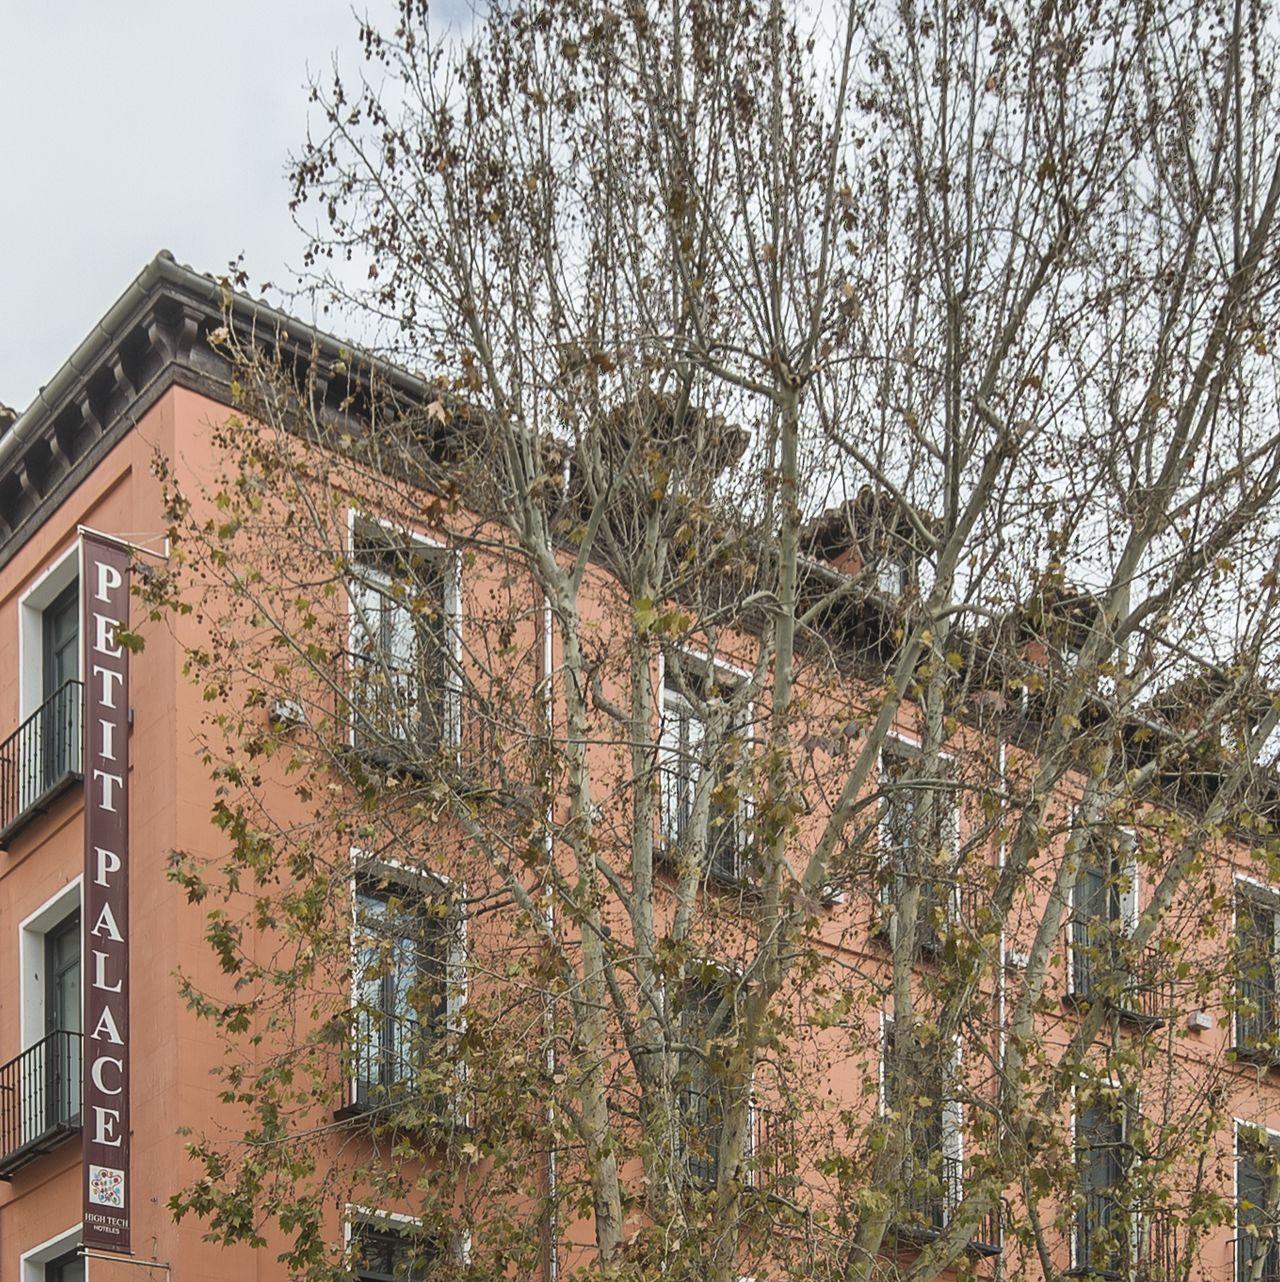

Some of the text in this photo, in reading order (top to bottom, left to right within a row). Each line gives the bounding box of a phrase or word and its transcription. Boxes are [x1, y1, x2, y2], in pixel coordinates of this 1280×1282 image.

[90, 560, 125, 1148] PETIT PALACE
[85, 1212, 129, 1228] HIGH TECH
[93, 1224, 120, 1235] HOTELES
